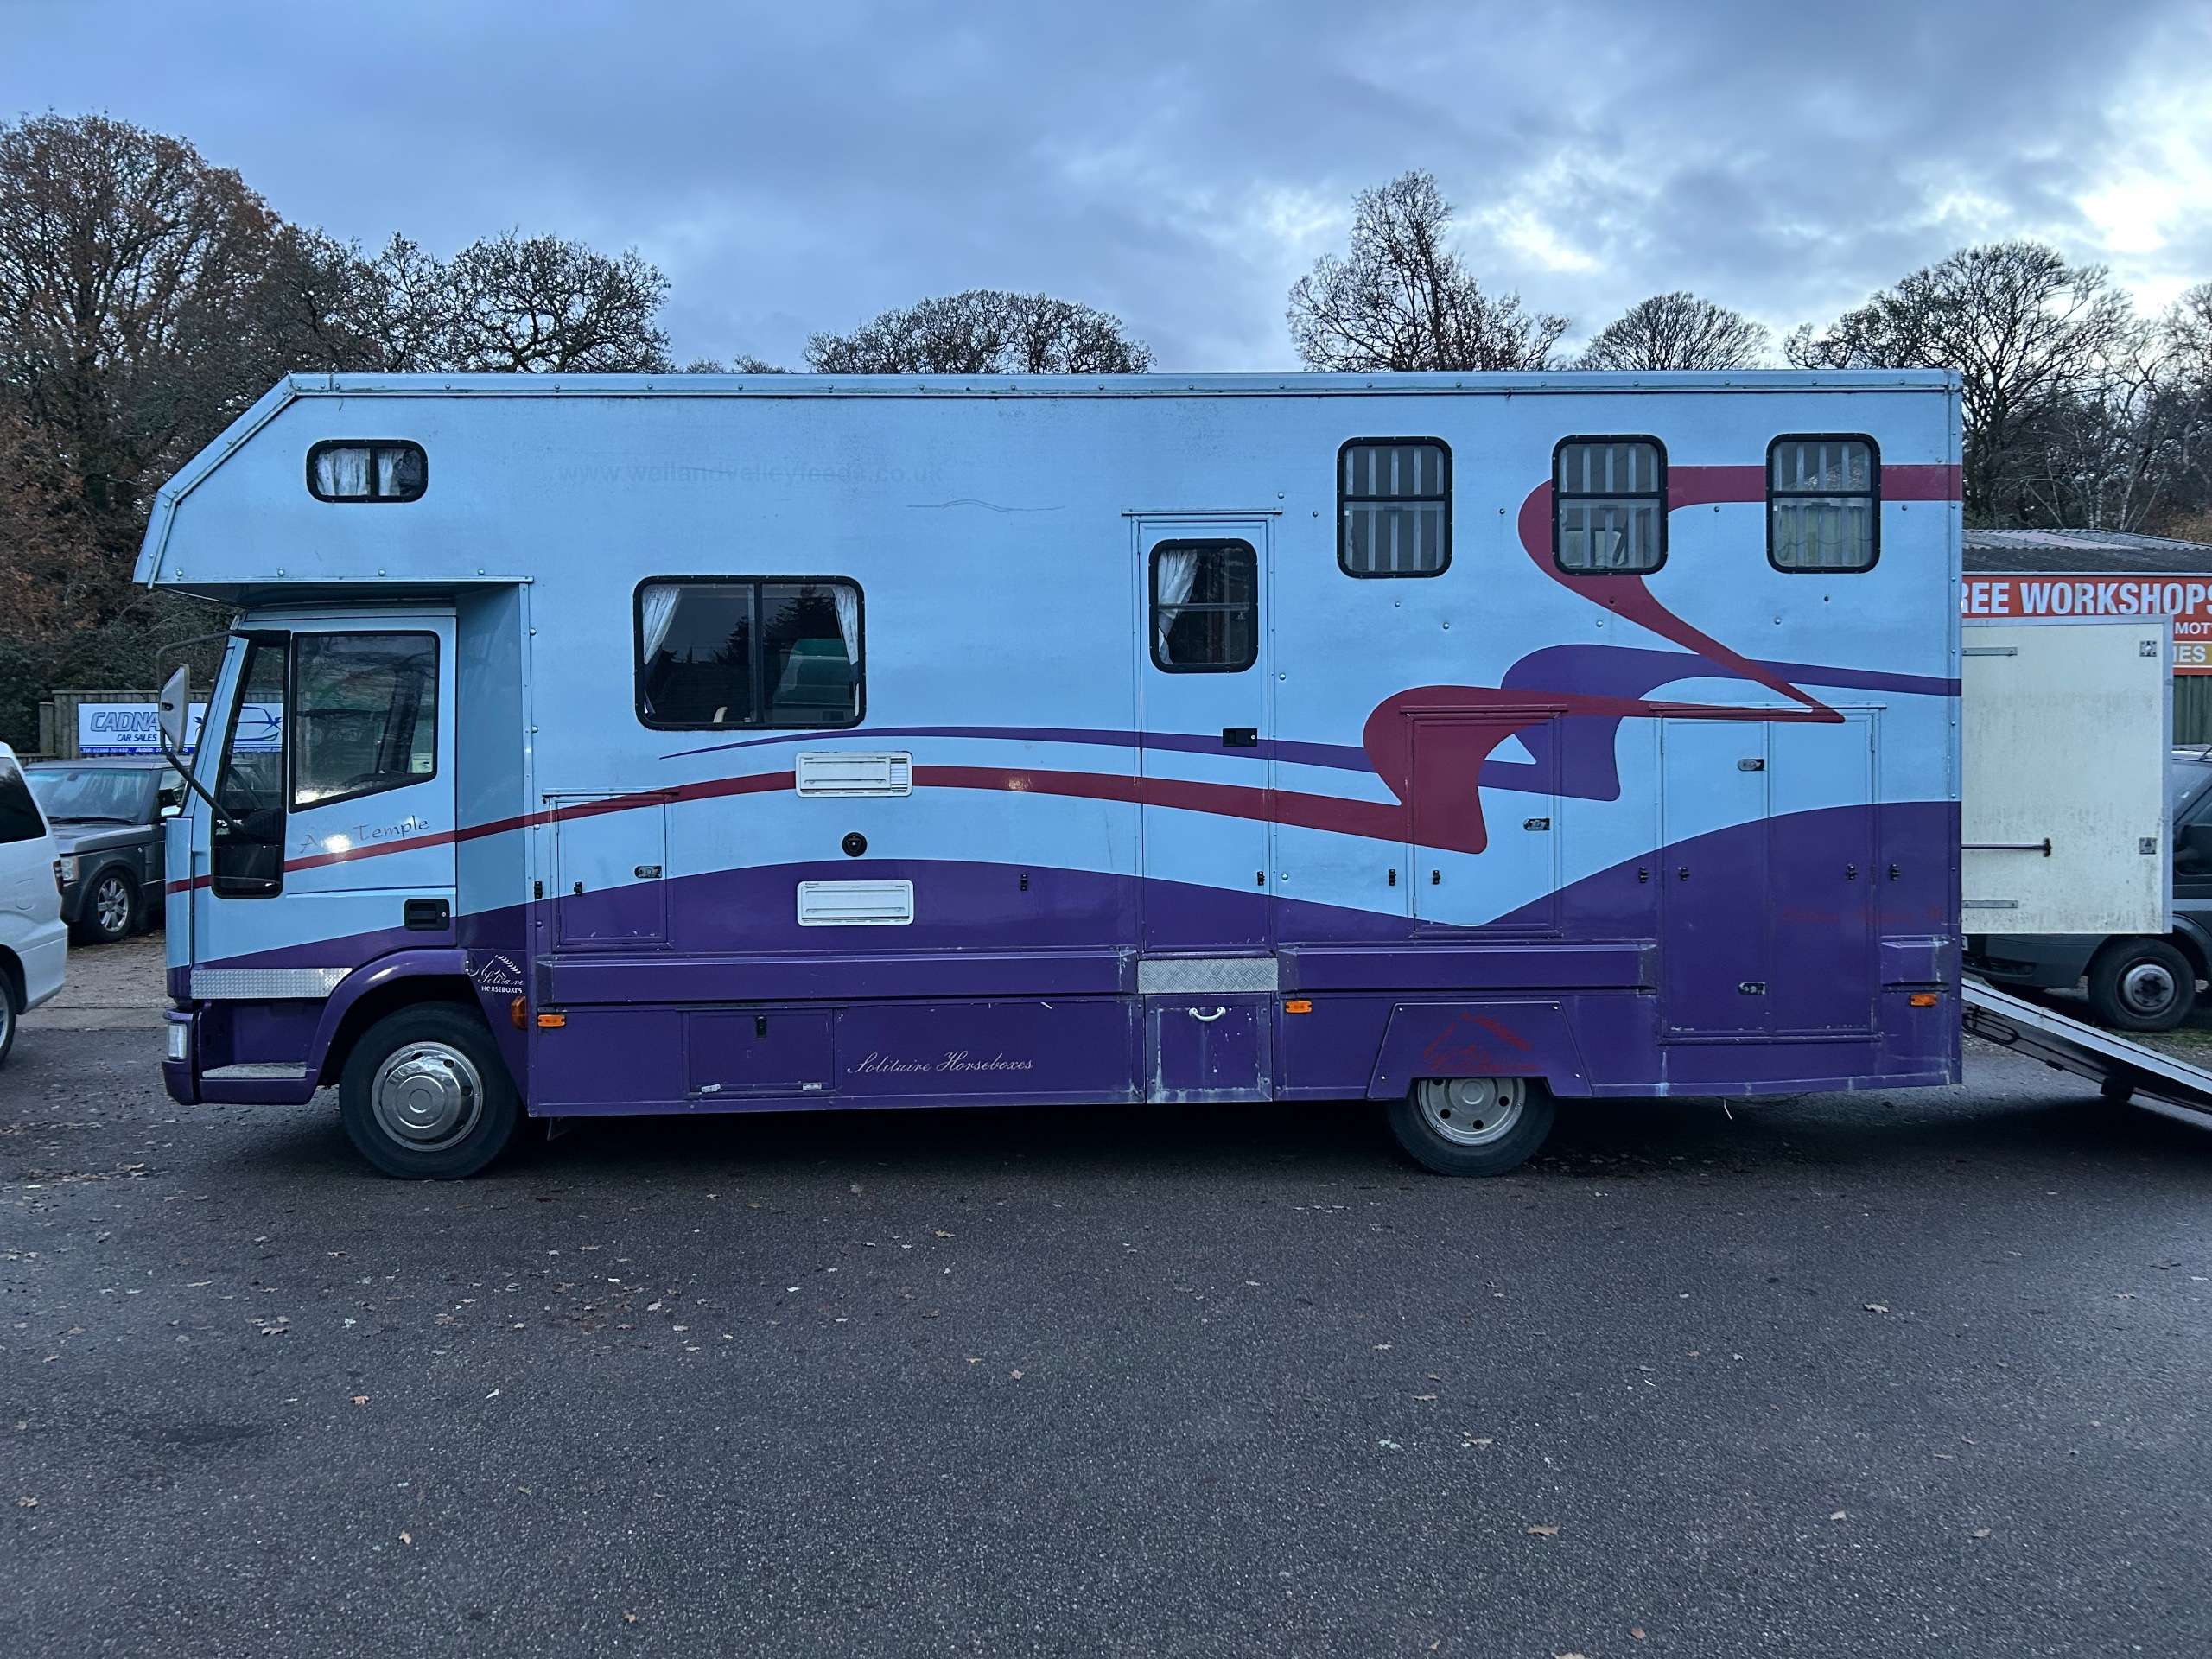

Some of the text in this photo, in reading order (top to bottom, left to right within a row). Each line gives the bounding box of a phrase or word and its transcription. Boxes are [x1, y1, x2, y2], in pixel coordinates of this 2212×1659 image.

[2020, 582, 2212, 614] WORKSHOP
[353, 815, 429, 841] Temple
[847, 1050, 1034, 1073] Solitaire Horseboxes
